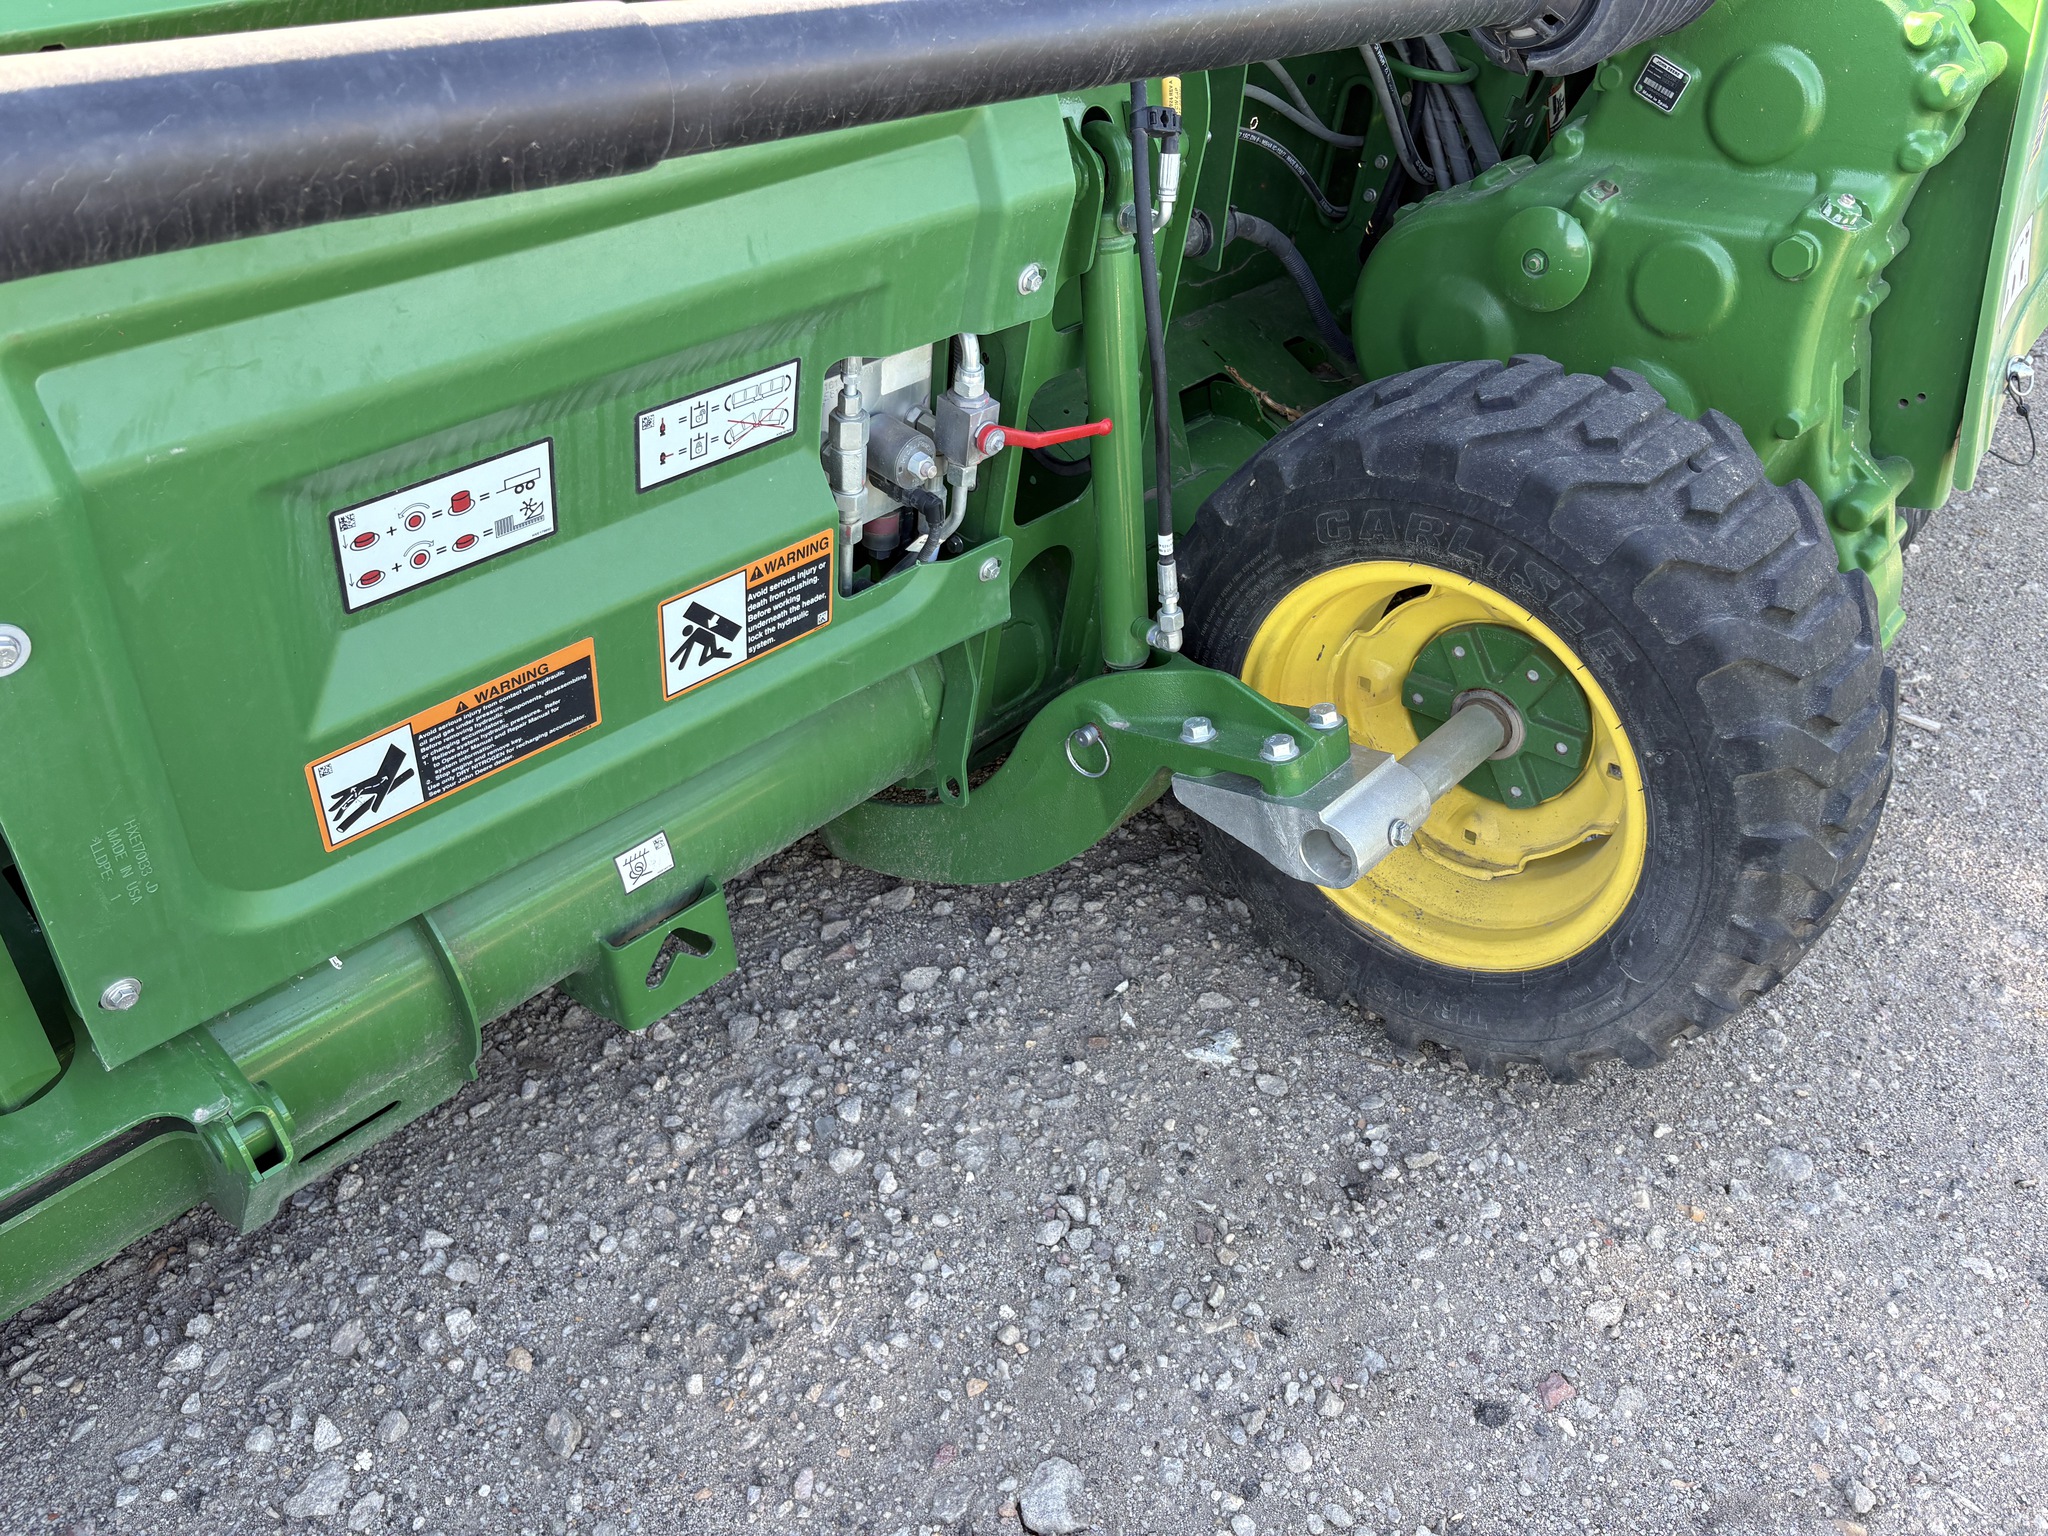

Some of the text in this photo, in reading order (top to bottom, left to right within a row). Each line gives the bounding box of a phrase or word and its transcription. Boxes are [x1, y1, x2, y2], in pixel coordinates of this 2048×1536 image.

[1656, 60, 1667, 69] JOHN
[1642, 89, 1653, 99] Made
[1657, 98, 1669, 109] Spain
[764, 536, 828, 574] WARNING
[747, 561, 826, 602] Avoid serious injury or
[747, 575, 820, 612] death from crushing.
[1315, 508, 1637, 672] CARLISLE
[747, 593, 800, 623] Before working
[747, 592, 826, 633] underneath the header,
[748, 631, 763, 643] lock
[764, 625, 776, 635] the
[777, 610, 809, 630] hydraulic
[748, 636, 776, 653] system.
[474, 663, 548, 703] WARNING
[418, 670, 565, 740] Avoid serious injury from contact with hydraulic
[420, 740, 442, 753] Before
[443, 726, 473, 743] removing
[473, 712, 503, 728] hydraulic
[544, 673, 587, 696] disassembling
[418, 738, 428, 747] oil
[428, 732, 442, 742] and
[442, 727, 455, 737] gas
[455, 718, 474, 730] under
[429, 738, 460, 756] changing
[431, 748, 456, 762] Relieve
[456, 736, 480, 750] system
[480, 722, 509, 739] hydraulic
[544, 698, 561, 709] Refer
[441, 747, 469, 764] Operator
[470, 736, 493, 750] Manual
[494, 730, 506, 740] and
[506, 721, 527, 734] Repair
[527, 709, 550, 724] Manual
[427, 782, 440, 791] Use
[441, 774, 455, 784] only
[456, 766, 470, 777] DRY
[470, 750, 505, 770] NITROGEN
[506, 746, 515, 754] for
[515, 731, 548, 749] recharging
[434, 770, 451, 780] Stop
[451, 760, 473, 773] engine
[473, 752, 486, 763] and
[486, 742, 510, 756] remove
[434, 760, 458, 774] system
[428, 788, 441, 797] See
[441, 780, 456, 792] your
[457, 773, 474, 784] John
[474, 764, 493, 775] Deere
[106, 827, 143, 905] MADE IN USA
[124, 818, 153, 877] HXE170133
